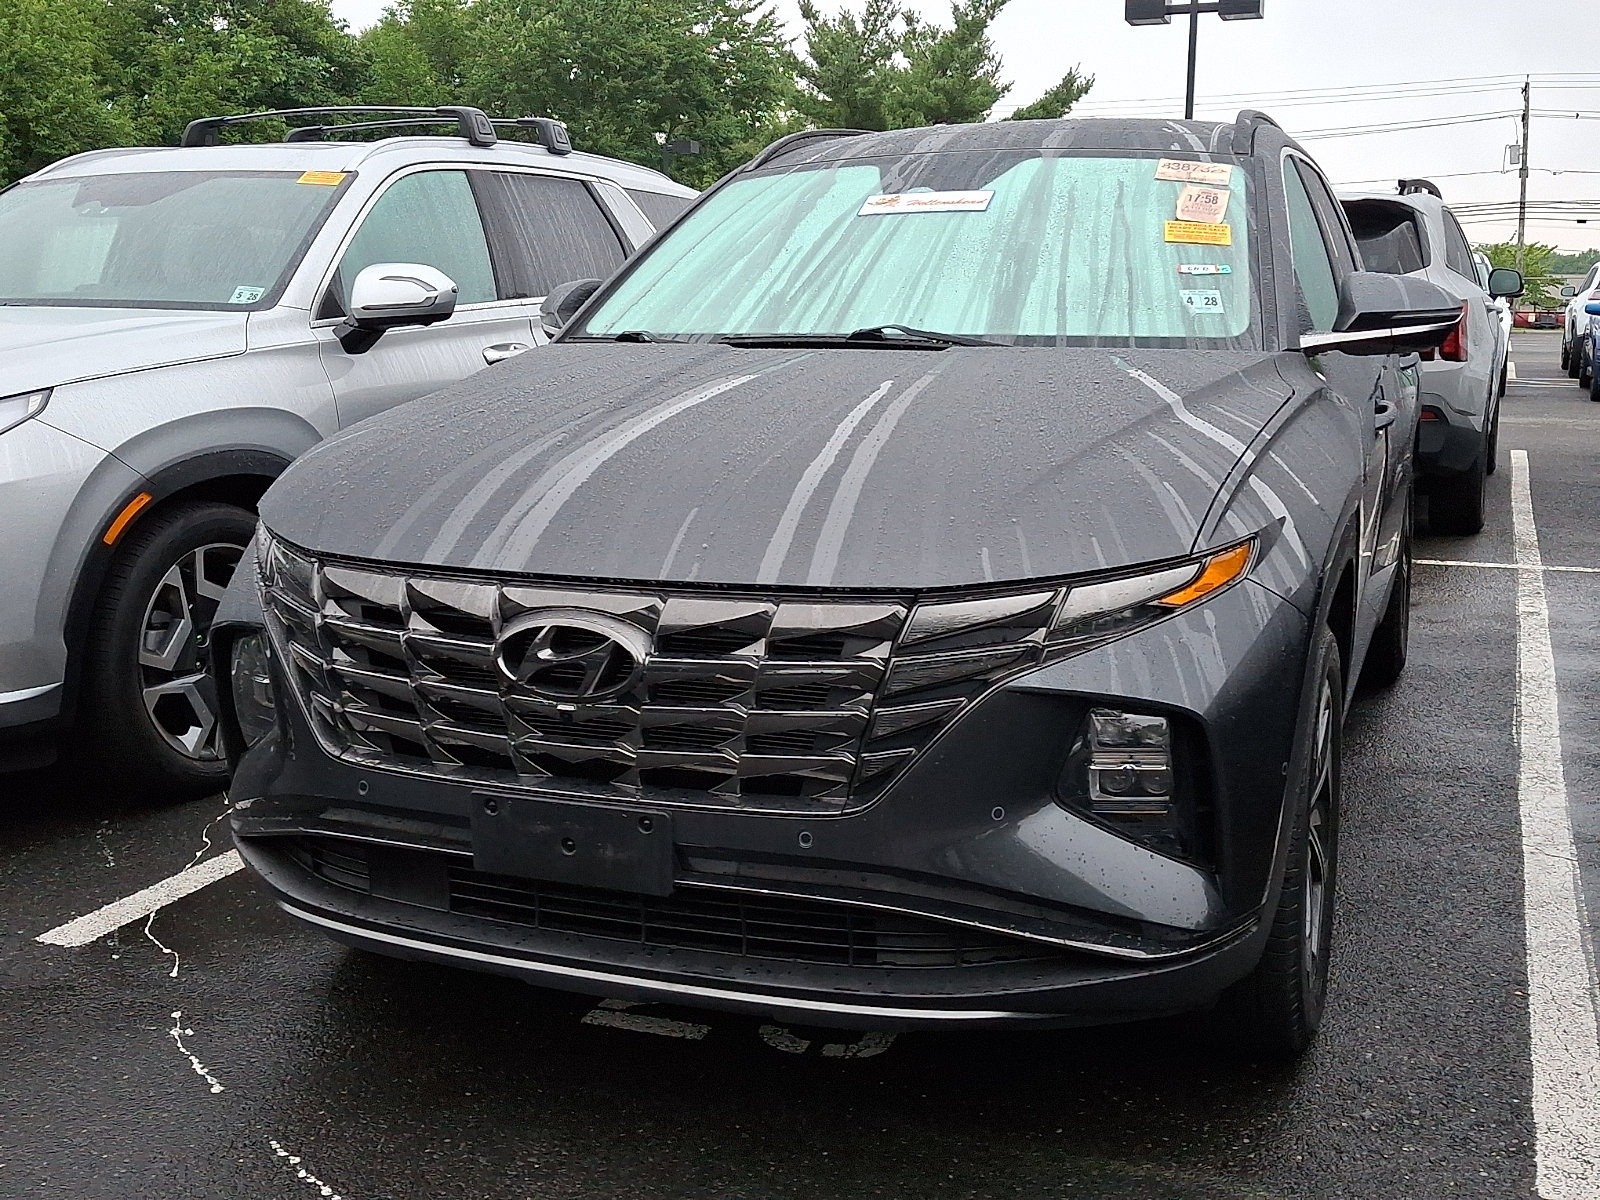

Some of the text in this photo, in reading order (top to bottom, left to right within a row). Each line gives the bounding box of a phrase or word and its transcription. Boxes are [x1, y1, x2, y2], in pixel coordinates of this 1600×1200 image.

[1187, 193, 1219, 205] 17:58
[235, 291, 259, 300] 5 28
[1186, 296, 1218, 306] 4 28
